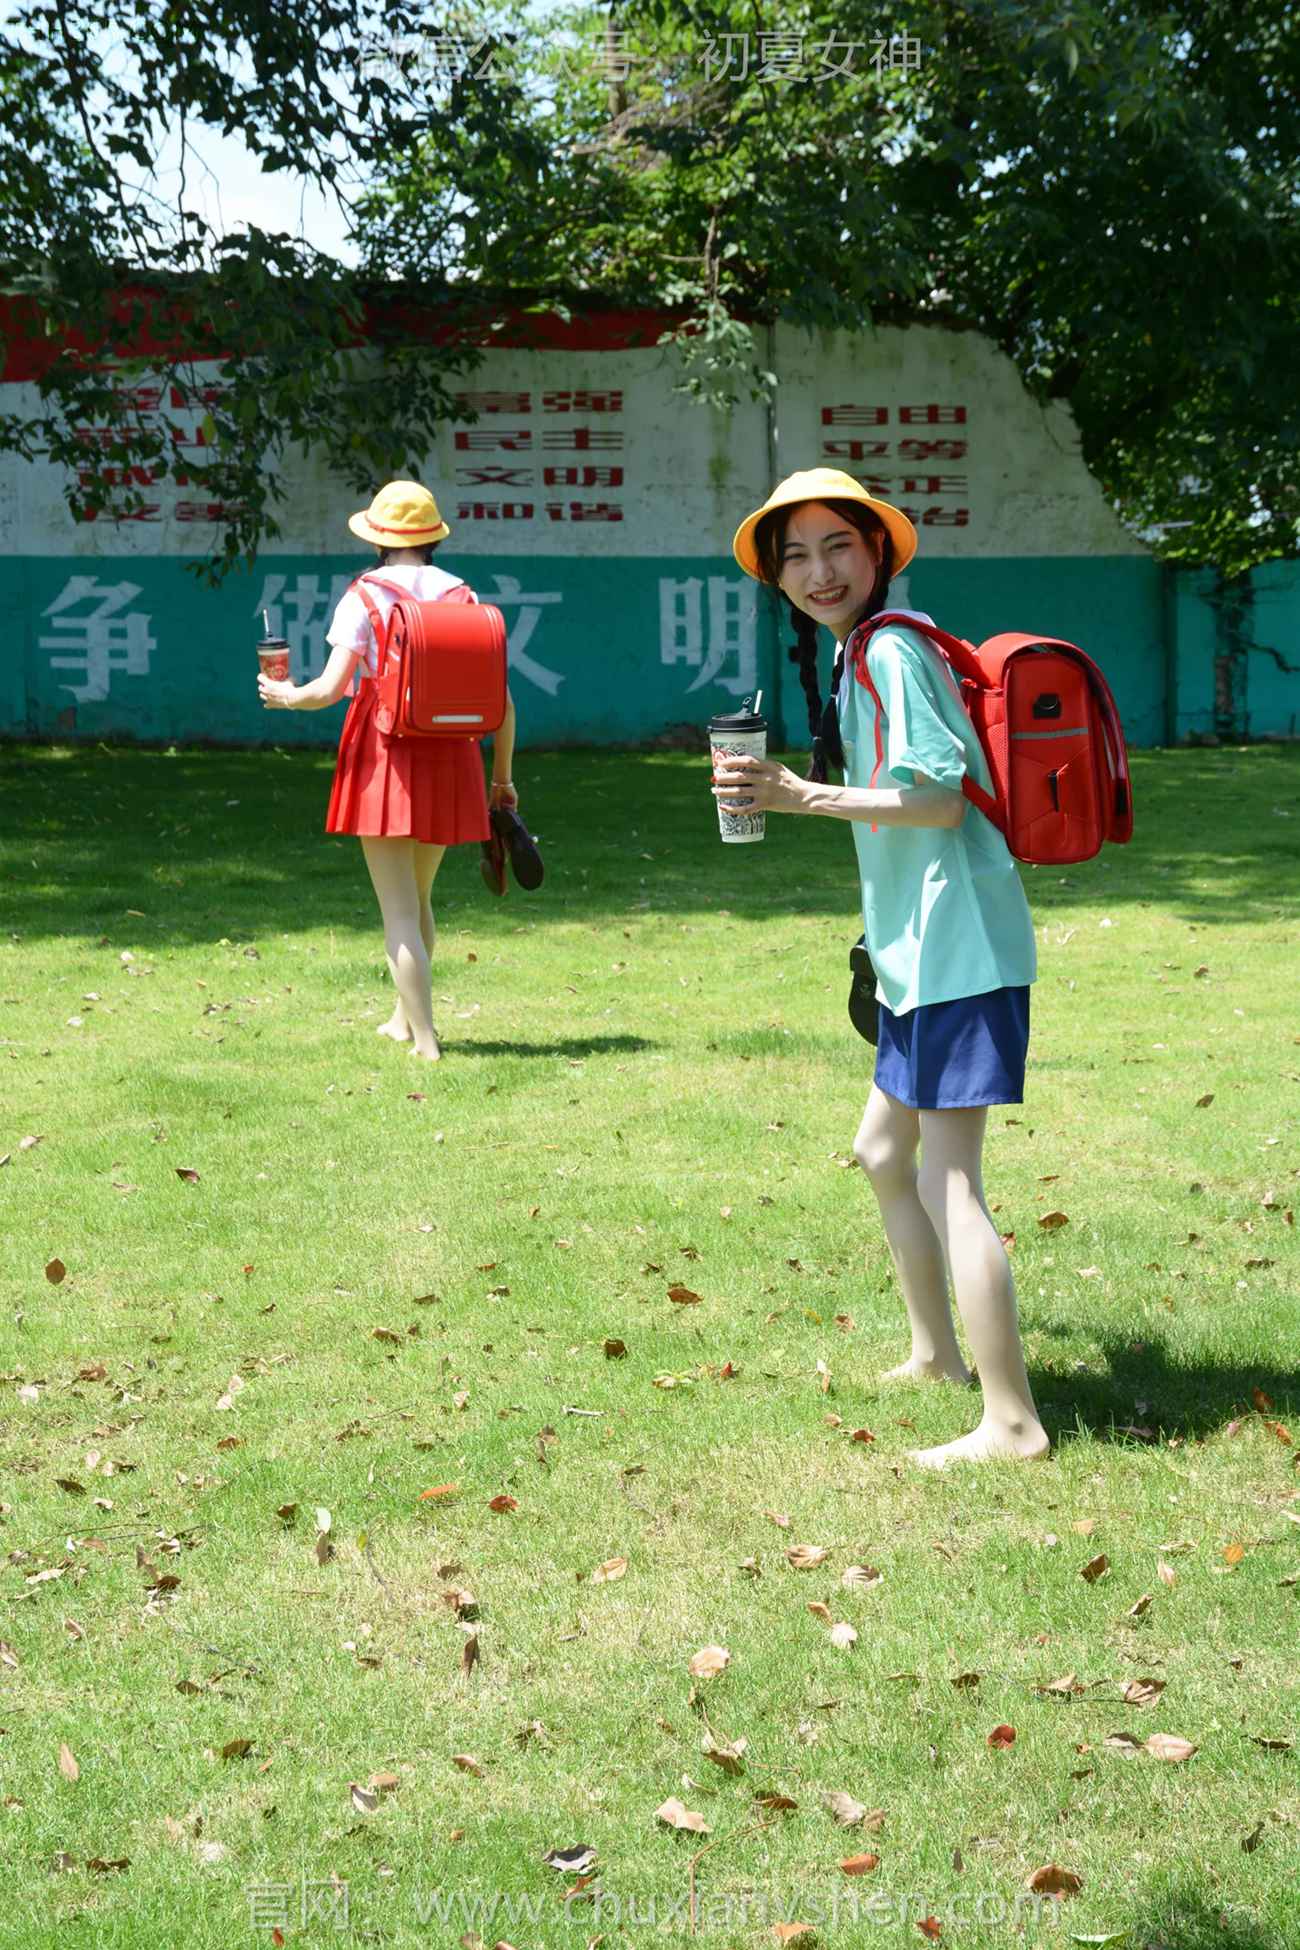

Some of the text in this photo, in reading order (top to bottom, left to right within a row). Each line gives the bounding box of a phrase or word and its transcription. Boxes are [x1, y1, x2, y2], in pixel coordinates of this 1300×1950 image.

[821, 404, 967, 426] 自由
[455, 426, 624, 451] 民主
[821, 438, 968, 460] 平等
[455, 466, 624, 487] 文明
[456, 501, 624, 521] 和谐
